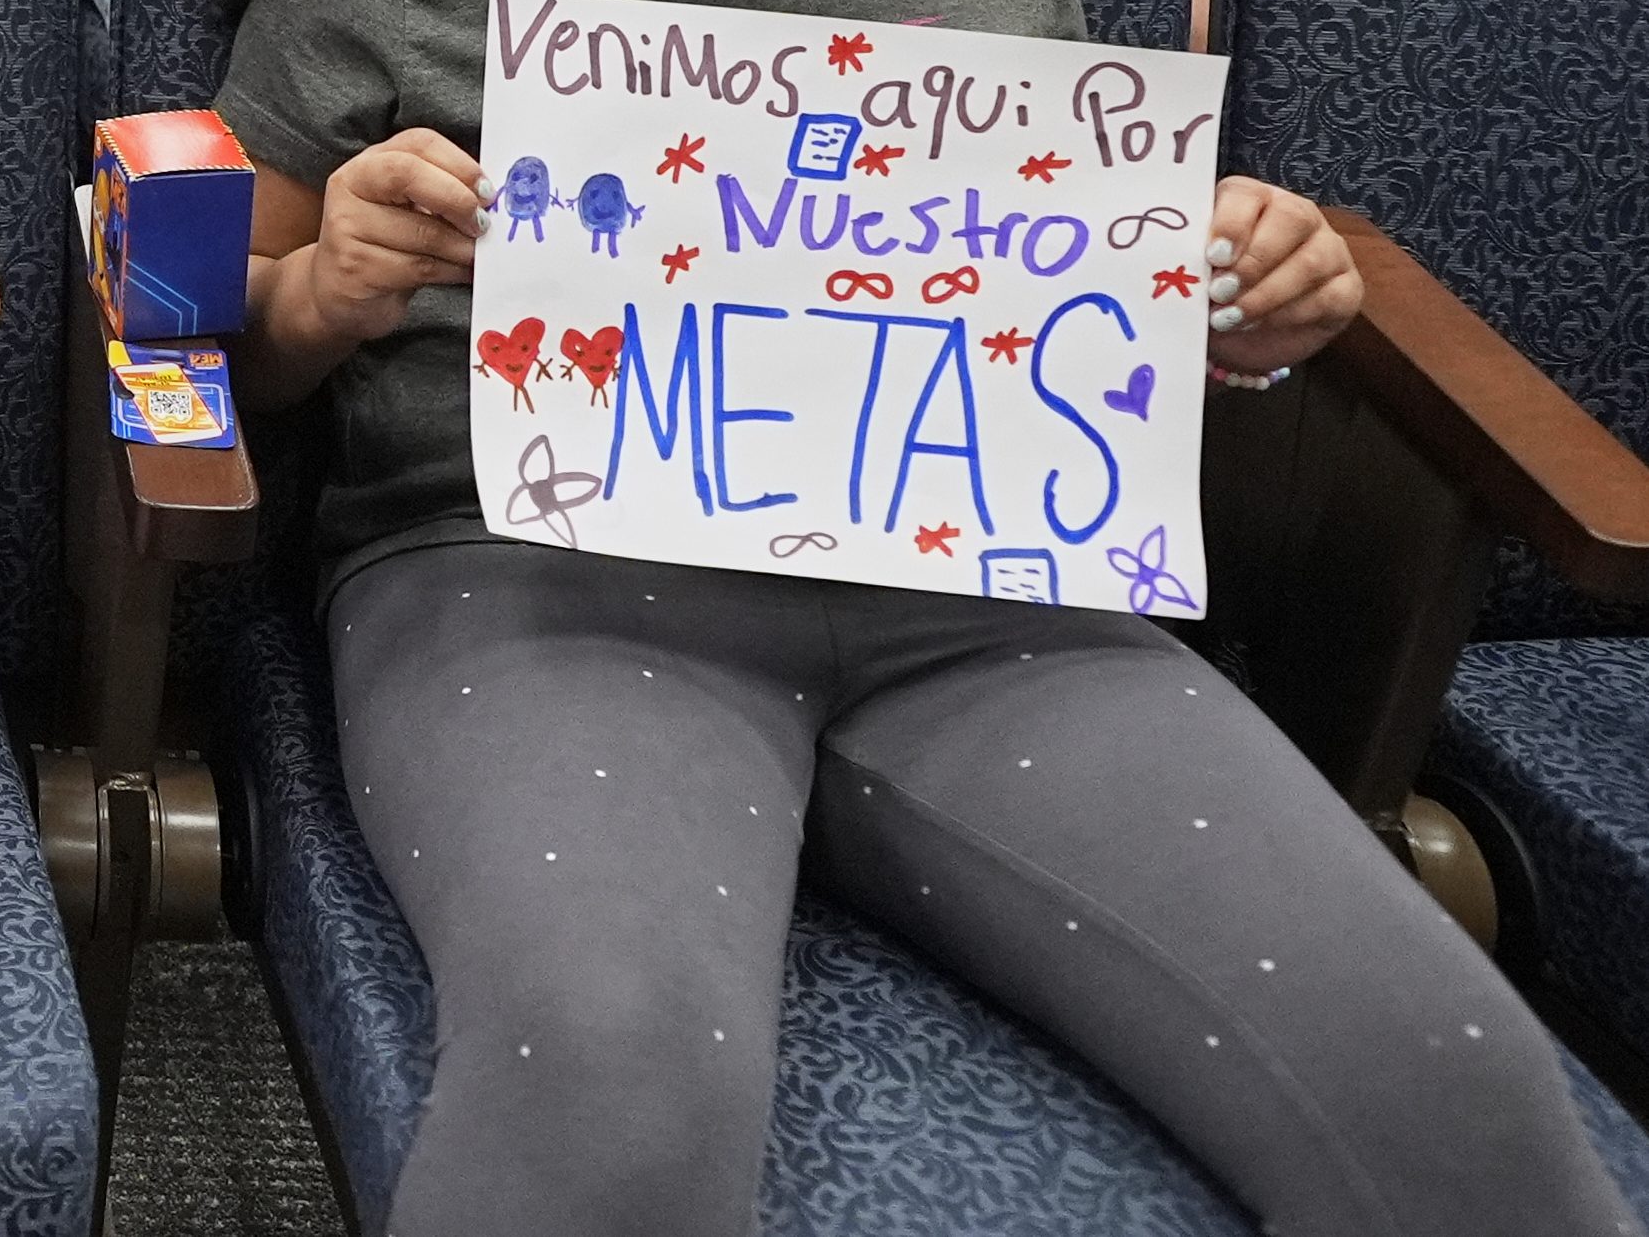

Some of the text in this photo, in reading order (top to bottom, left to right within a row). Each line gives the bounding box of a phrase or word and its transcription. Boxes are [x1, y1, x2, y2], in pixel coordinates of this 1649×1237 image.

[860, 65, 1031, 159] aqui
[1073, 61, 1214, 167] Por
[603, 292, 1135, 543] METAS
